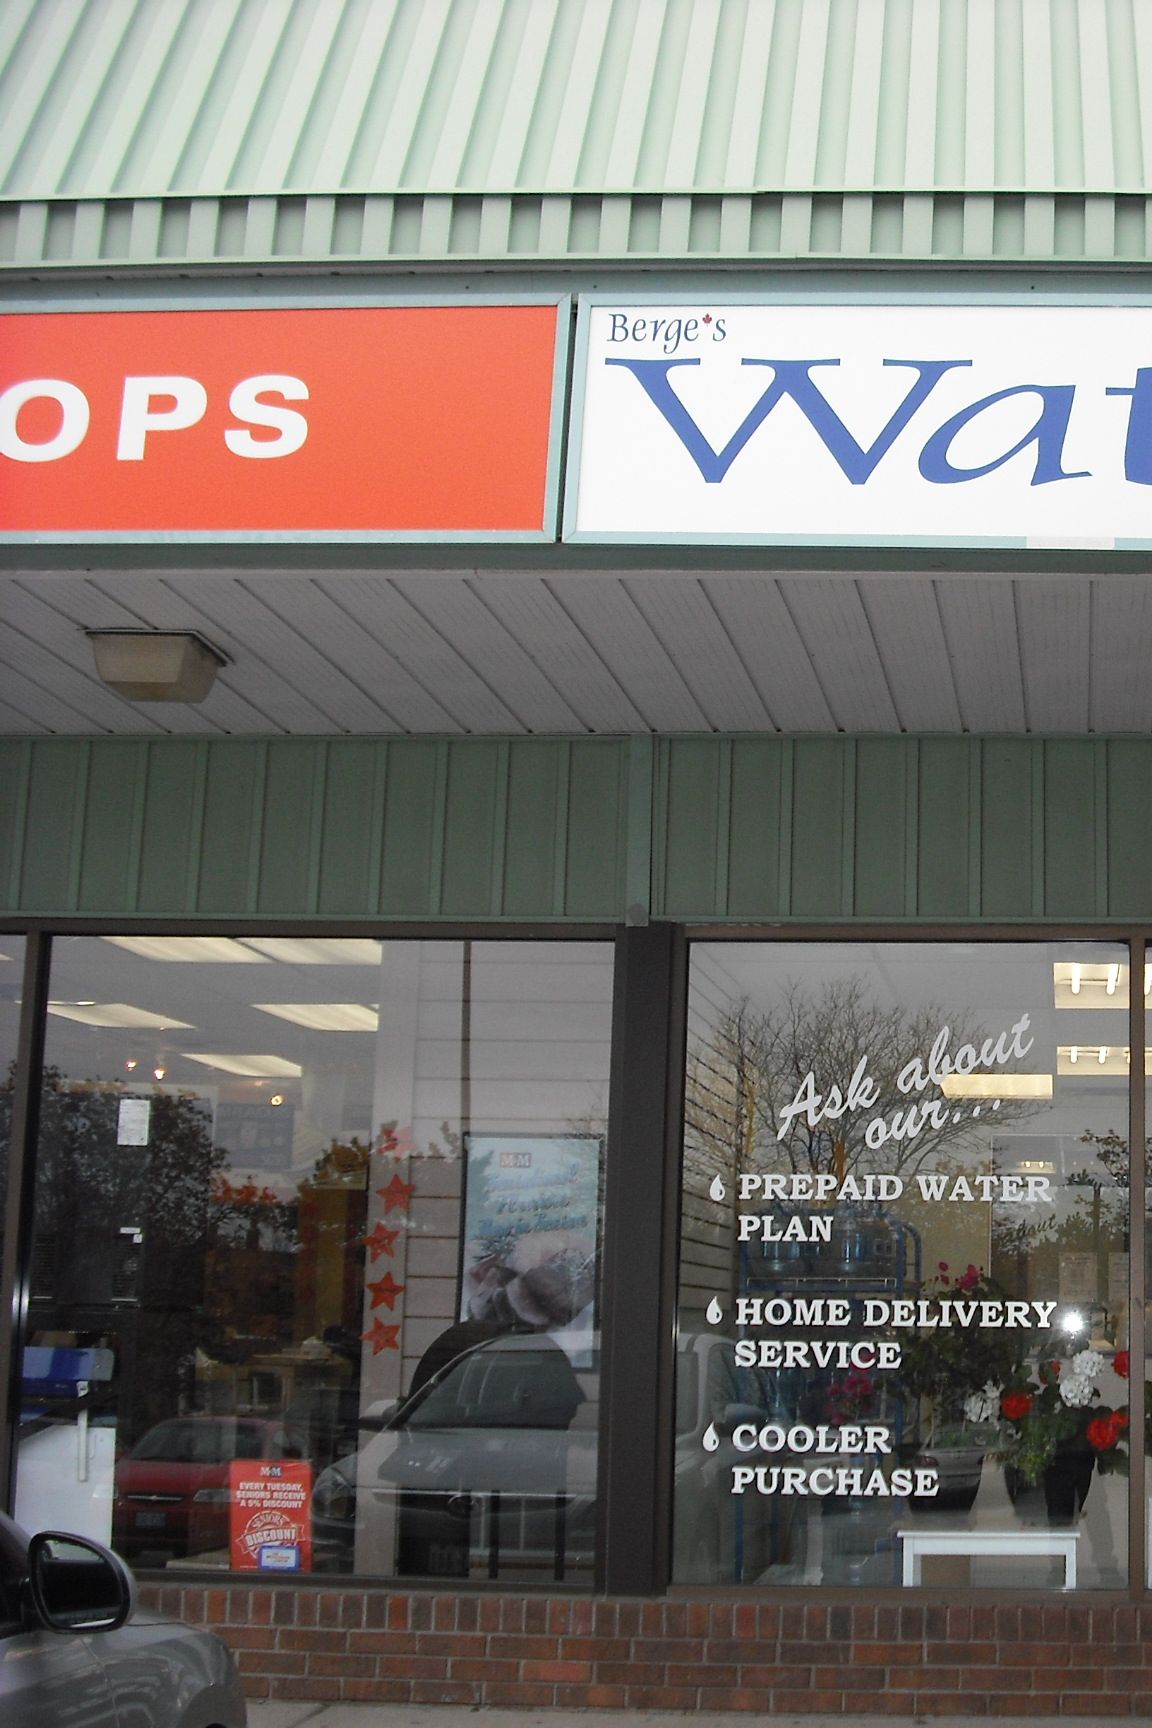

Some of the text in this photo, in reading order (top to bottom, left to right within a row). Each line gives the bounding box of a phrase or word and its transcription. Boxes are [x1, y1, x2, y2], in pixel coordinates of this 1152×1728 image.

[0, 375, 310, 463] OPS
[777, 1013, 1035, 1140] Ask about
[738, 1173, 1053, 1202] PREPAID WATER
[736, 1215, 834, 1243] PLAN
[735, 1298, 1058, 1329] HOME DELIVERY
[734, 1340, 902, 1370] SERVICE
[731, 1424, 892, 1454] COOLER
[236, 1490, 307, 1500] SENIORS RECEIVE
[239, 1482, 265, 1491] EVERY
[730, 1466, 940, 1497] PURCHASE
[239, 1500, 248, 1508] A
[262, 1500, 304, 1509] DISCOUNT
[245, 1528, 297, 1547] DISCOUNT
